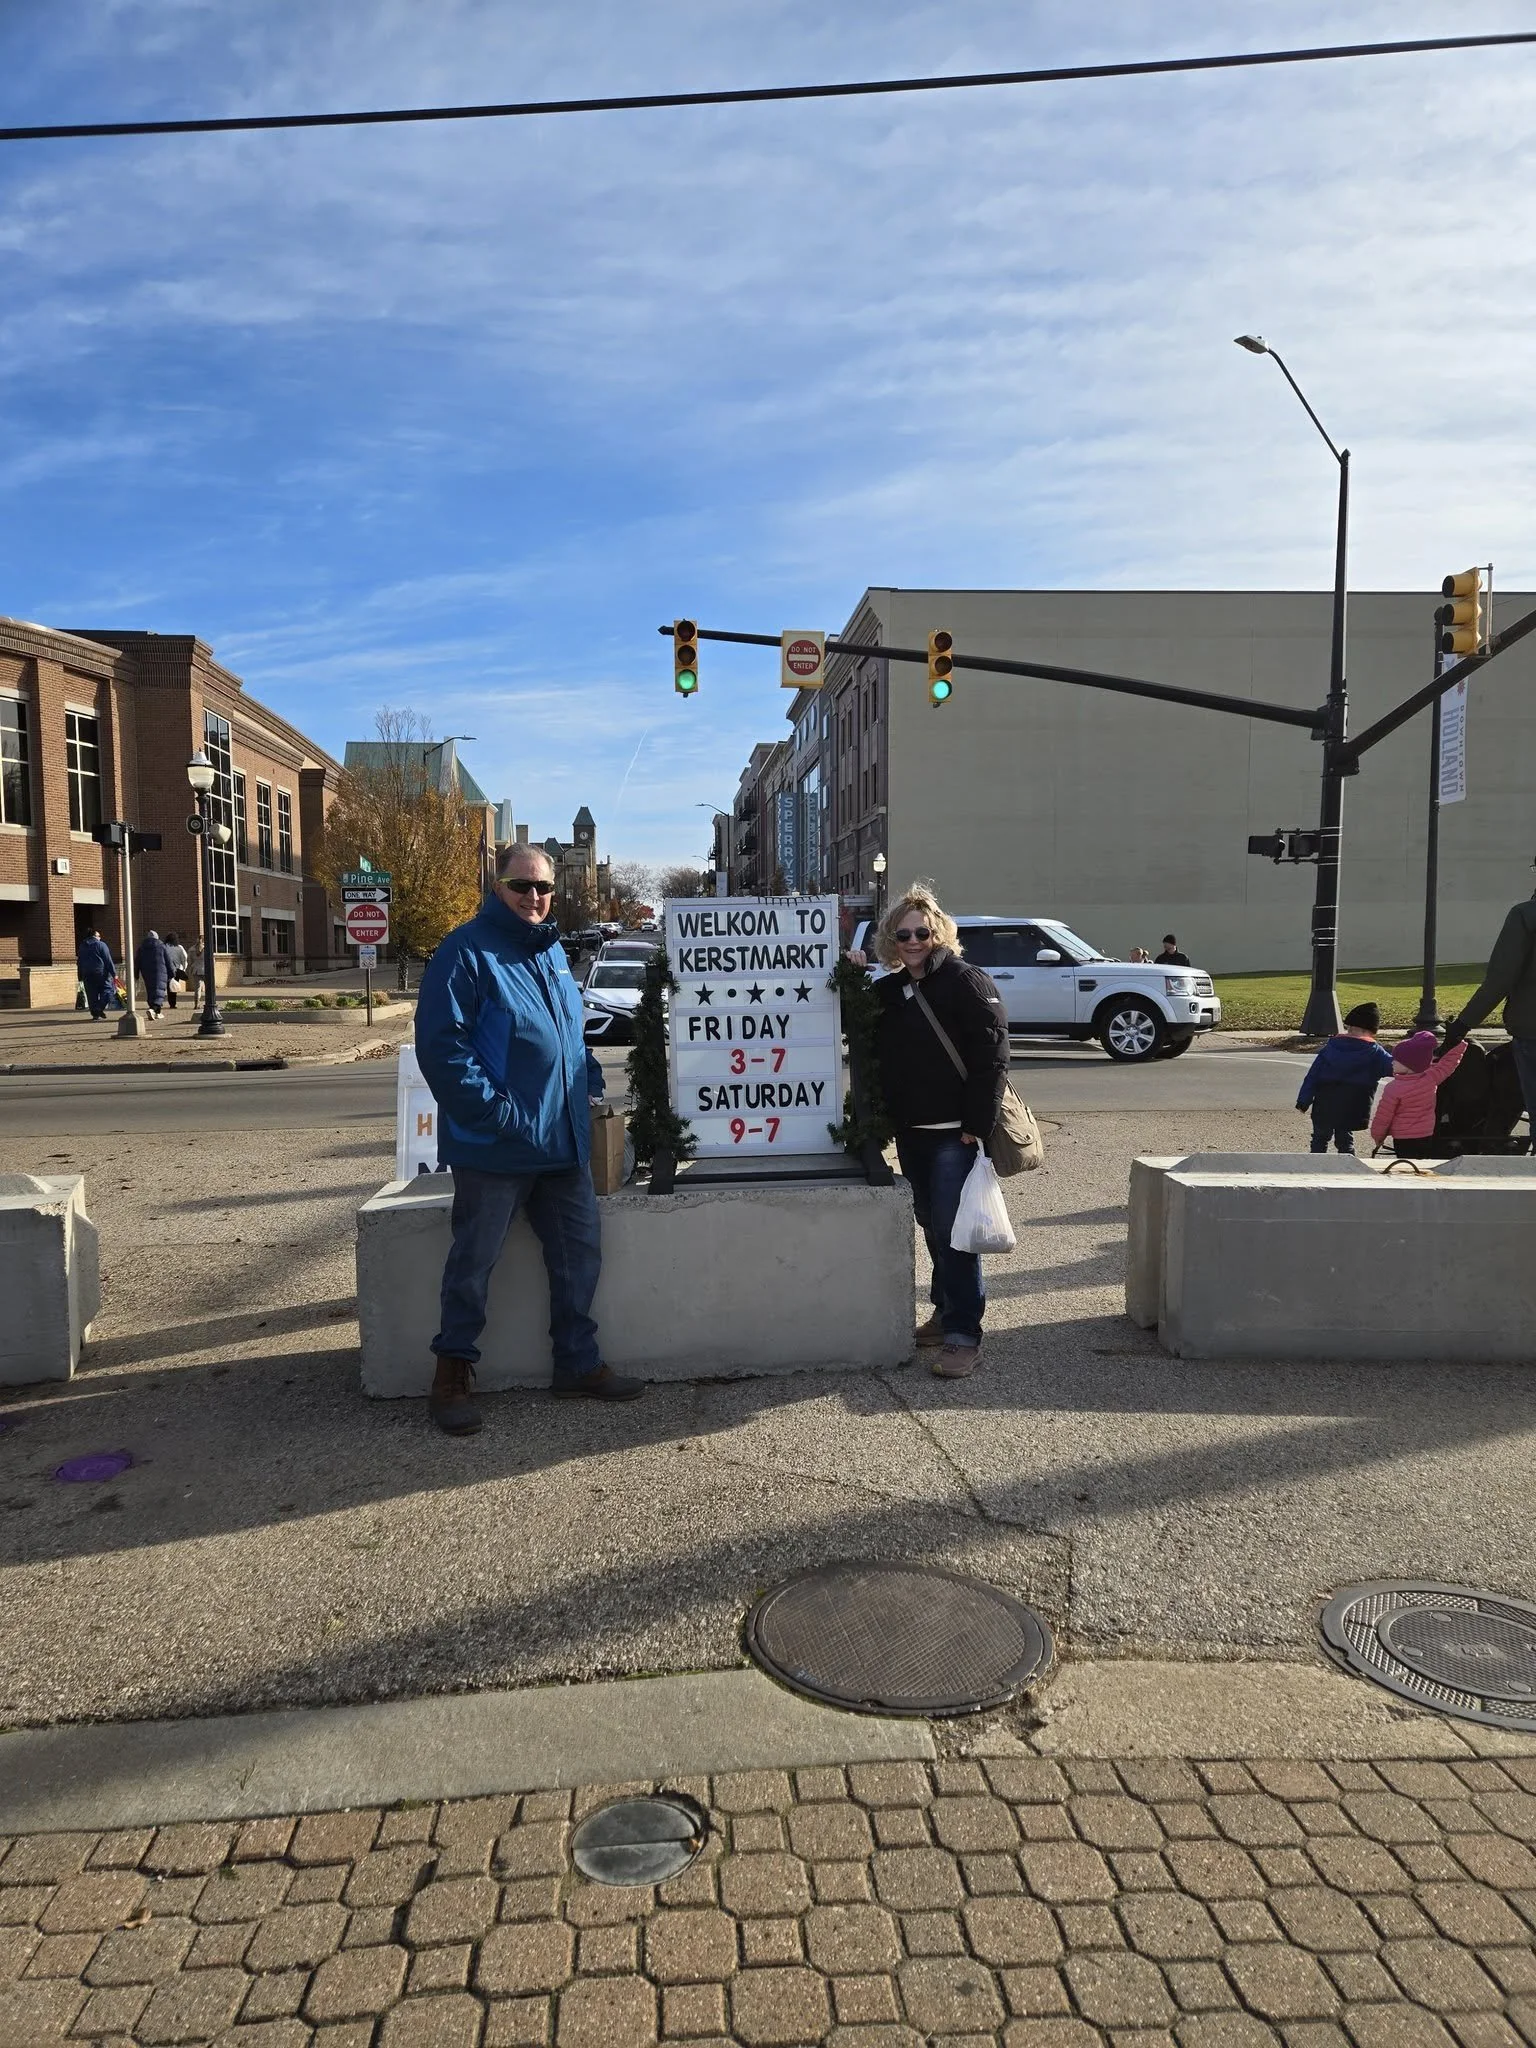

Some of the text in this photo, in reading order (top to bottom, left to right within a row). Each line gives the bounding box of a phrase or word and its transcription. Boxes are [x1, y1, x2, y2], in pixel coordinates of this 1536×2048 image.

[793, 662, 814, 670] ENTER
[1441, 707, 1459, 796] HOLLAND
[783, 797, 794, 885] SPERRY'S
[351, 873, 390, 884] Pine Ave
[346, 891, 360, 899] ONE
[356, 929, 379, 937] ENTER
[677, 908, 826, 938] WELKOM TO
[679, 943, 828, 973] KERSTMARKT
[688, 1014, 790, 1041] FRIDAY
[730, 1048, 786, 1075] 3-7
[698, 1081, 825, 1112] SATURDAY
[730, 1117, 781, 1144] 9-7
